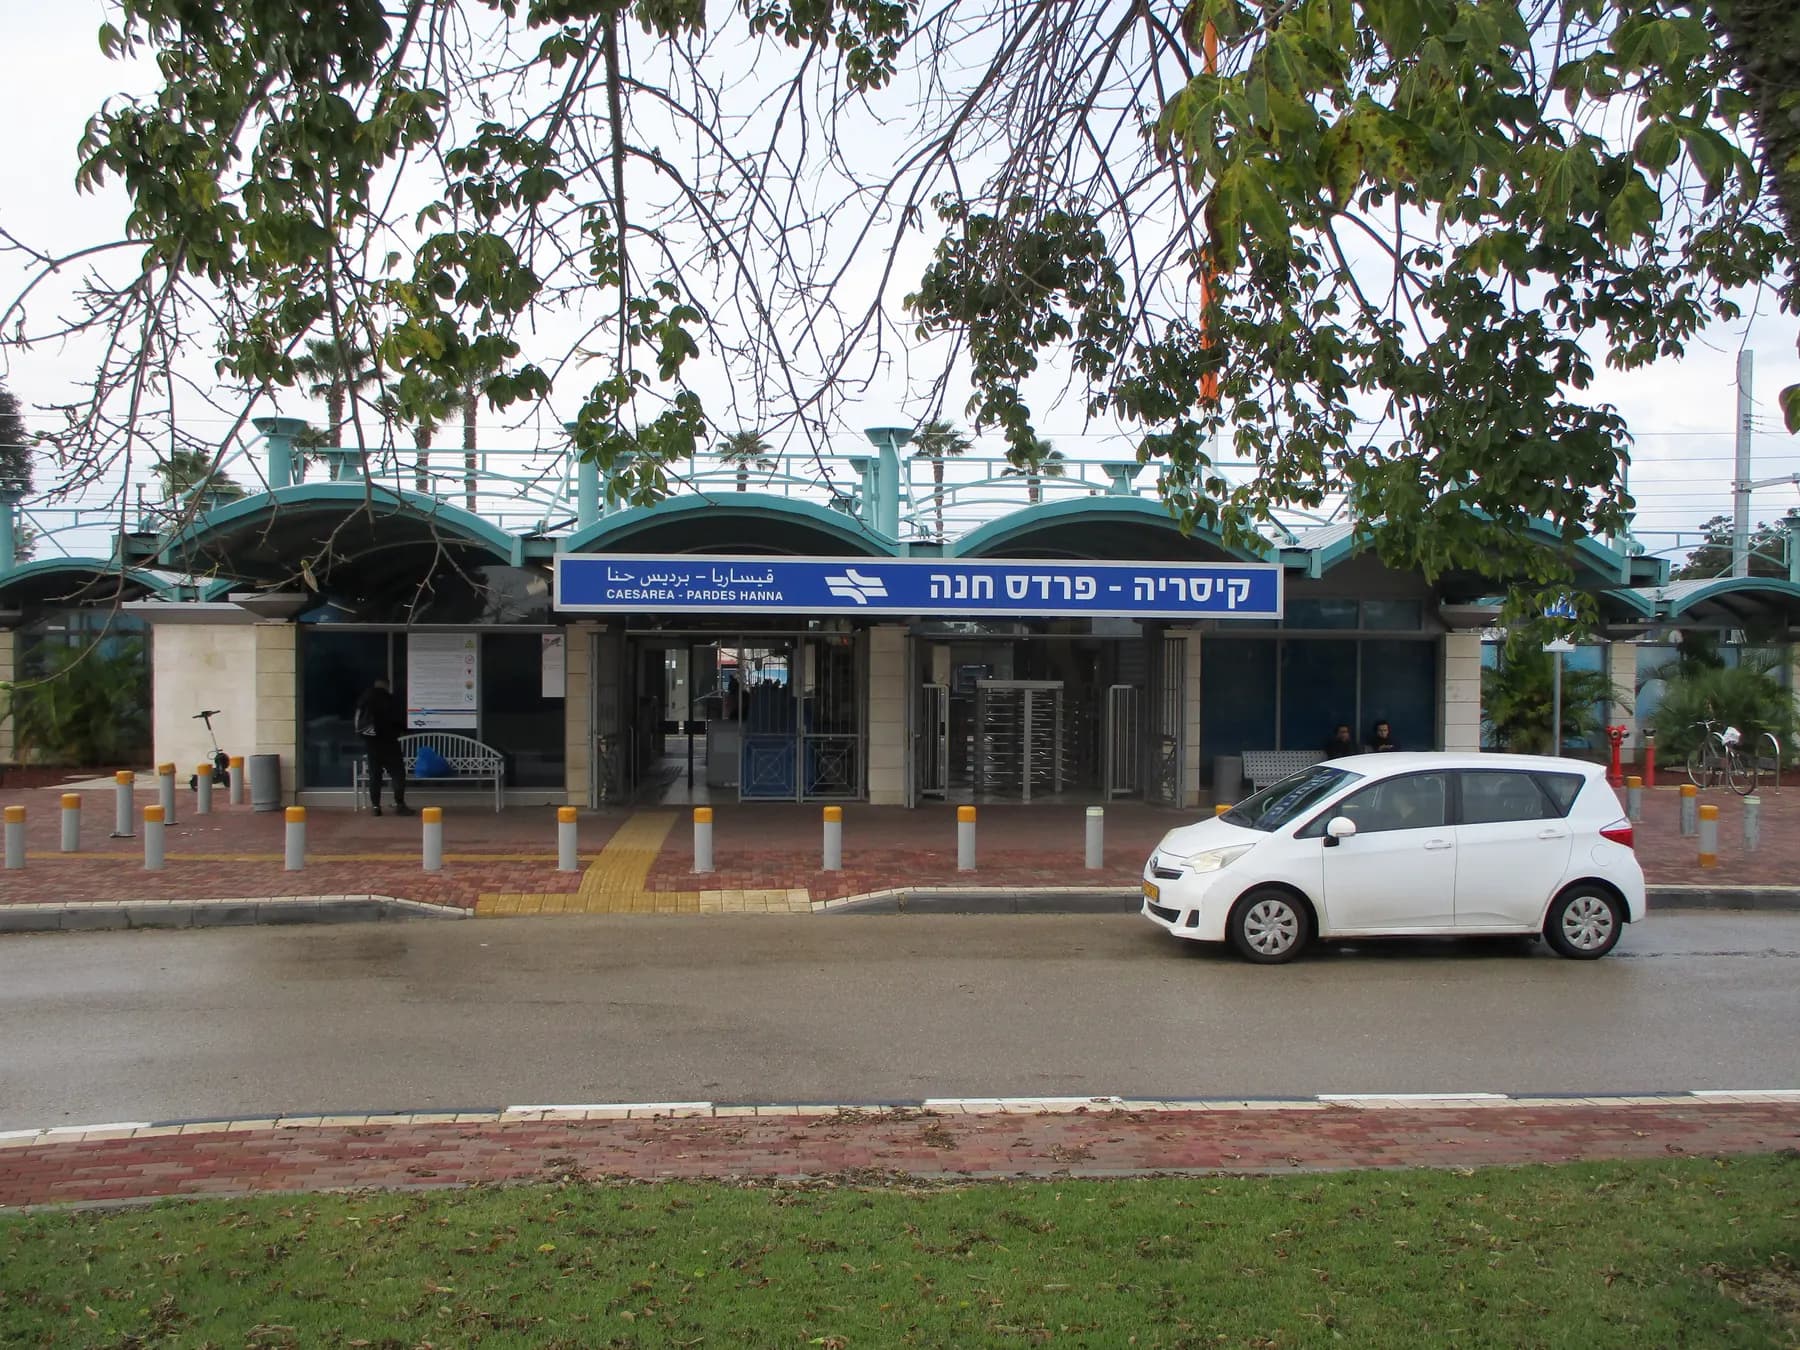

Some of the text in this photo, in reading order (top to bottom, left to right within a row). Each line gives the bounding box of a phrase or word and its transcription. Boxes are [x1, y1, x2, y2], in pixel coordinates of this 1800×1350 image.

[607, 567, 636, 582] حنا
[640, 573, 690, 588] برديس
[712, 567, 774, 588] قيساريا
[606, 589, 675, 600] CAESAREA
[687, 589, 737, 601] PARDES
[740, 590, 784, 601] HANNA
[930, 574, 994, 600] חנה
[1005, 574, 1097, 601] פרדס
[1133, 576, 1251, 610] קיסריה
